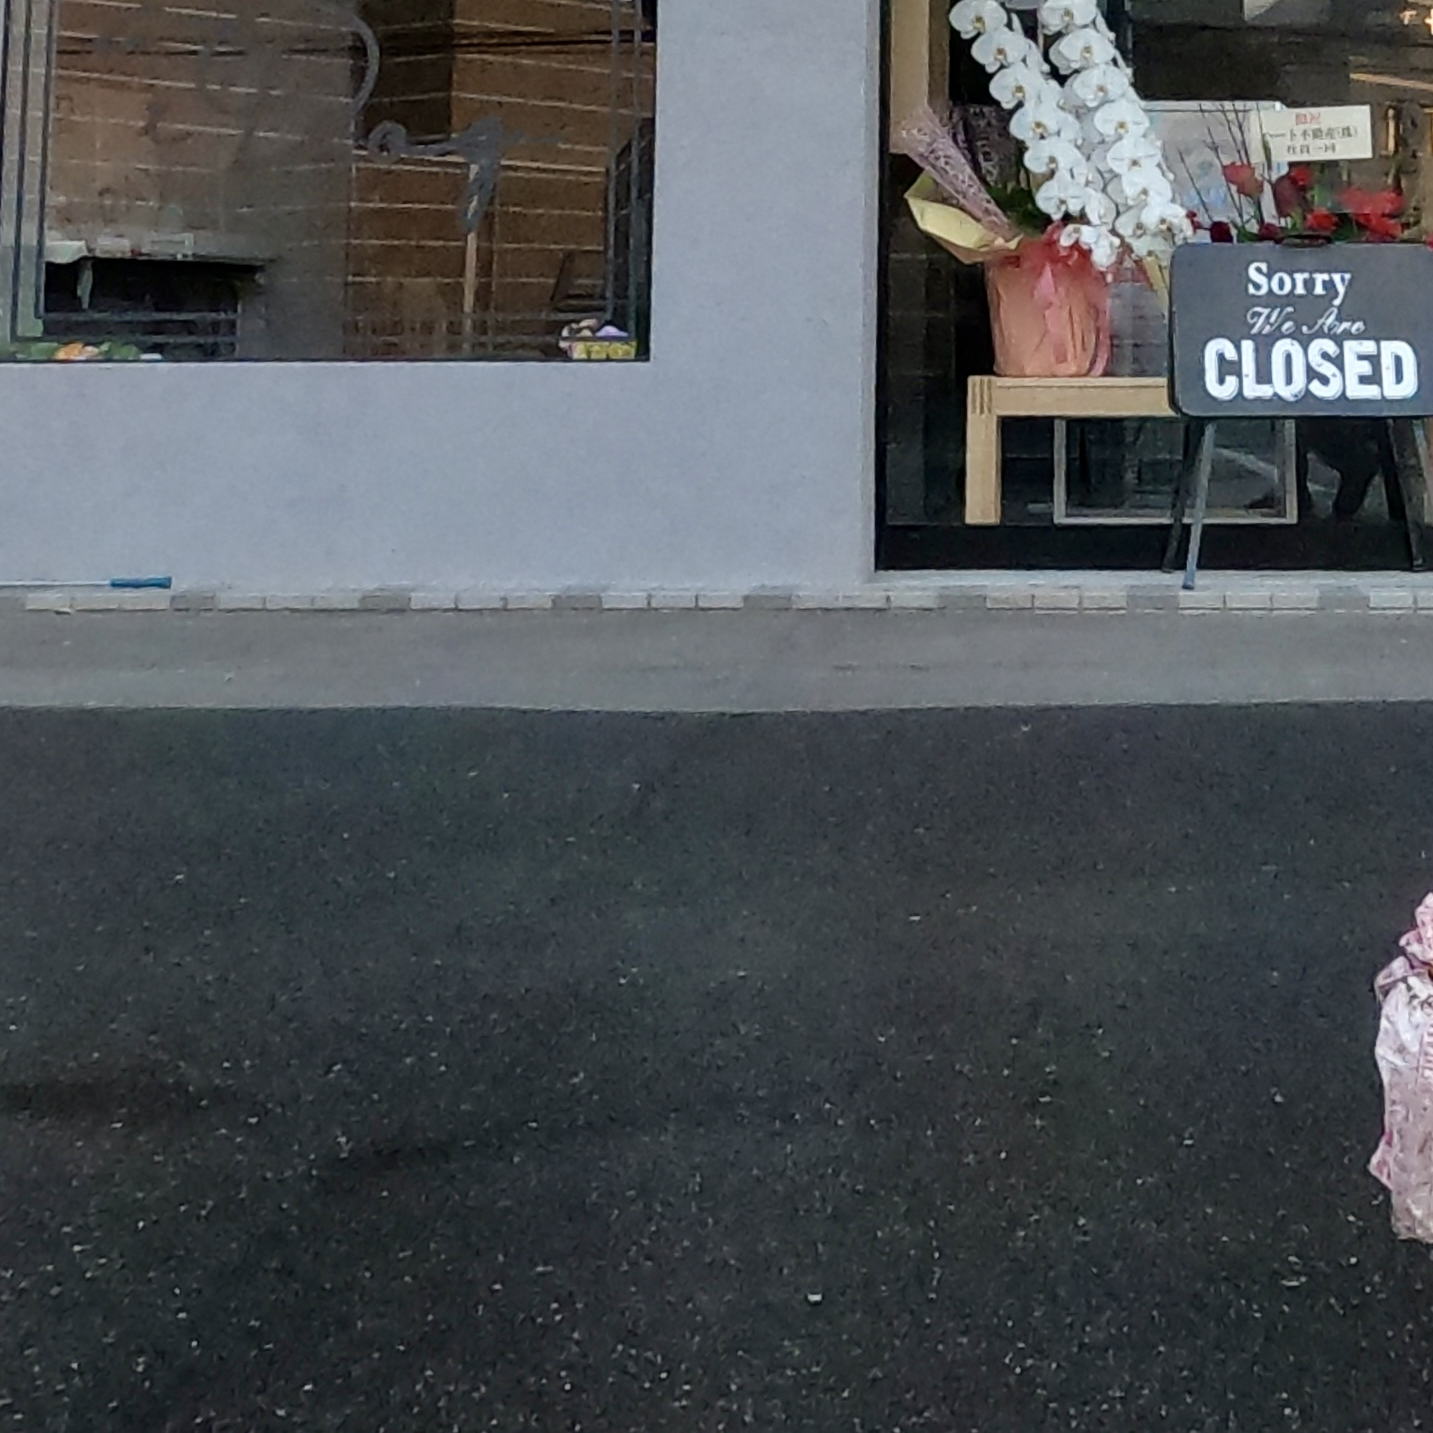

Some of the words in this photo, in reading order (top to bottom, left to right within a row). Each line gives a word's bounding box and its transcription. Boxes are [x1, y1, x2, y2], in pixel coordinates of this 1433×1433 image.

[1247, 261, 1351, 306] Sorry
[1246, 306, 1296, 335] We
[1301, 307, 1366, 335] Are
[1203, 337, 1419, 402] CLOSED
